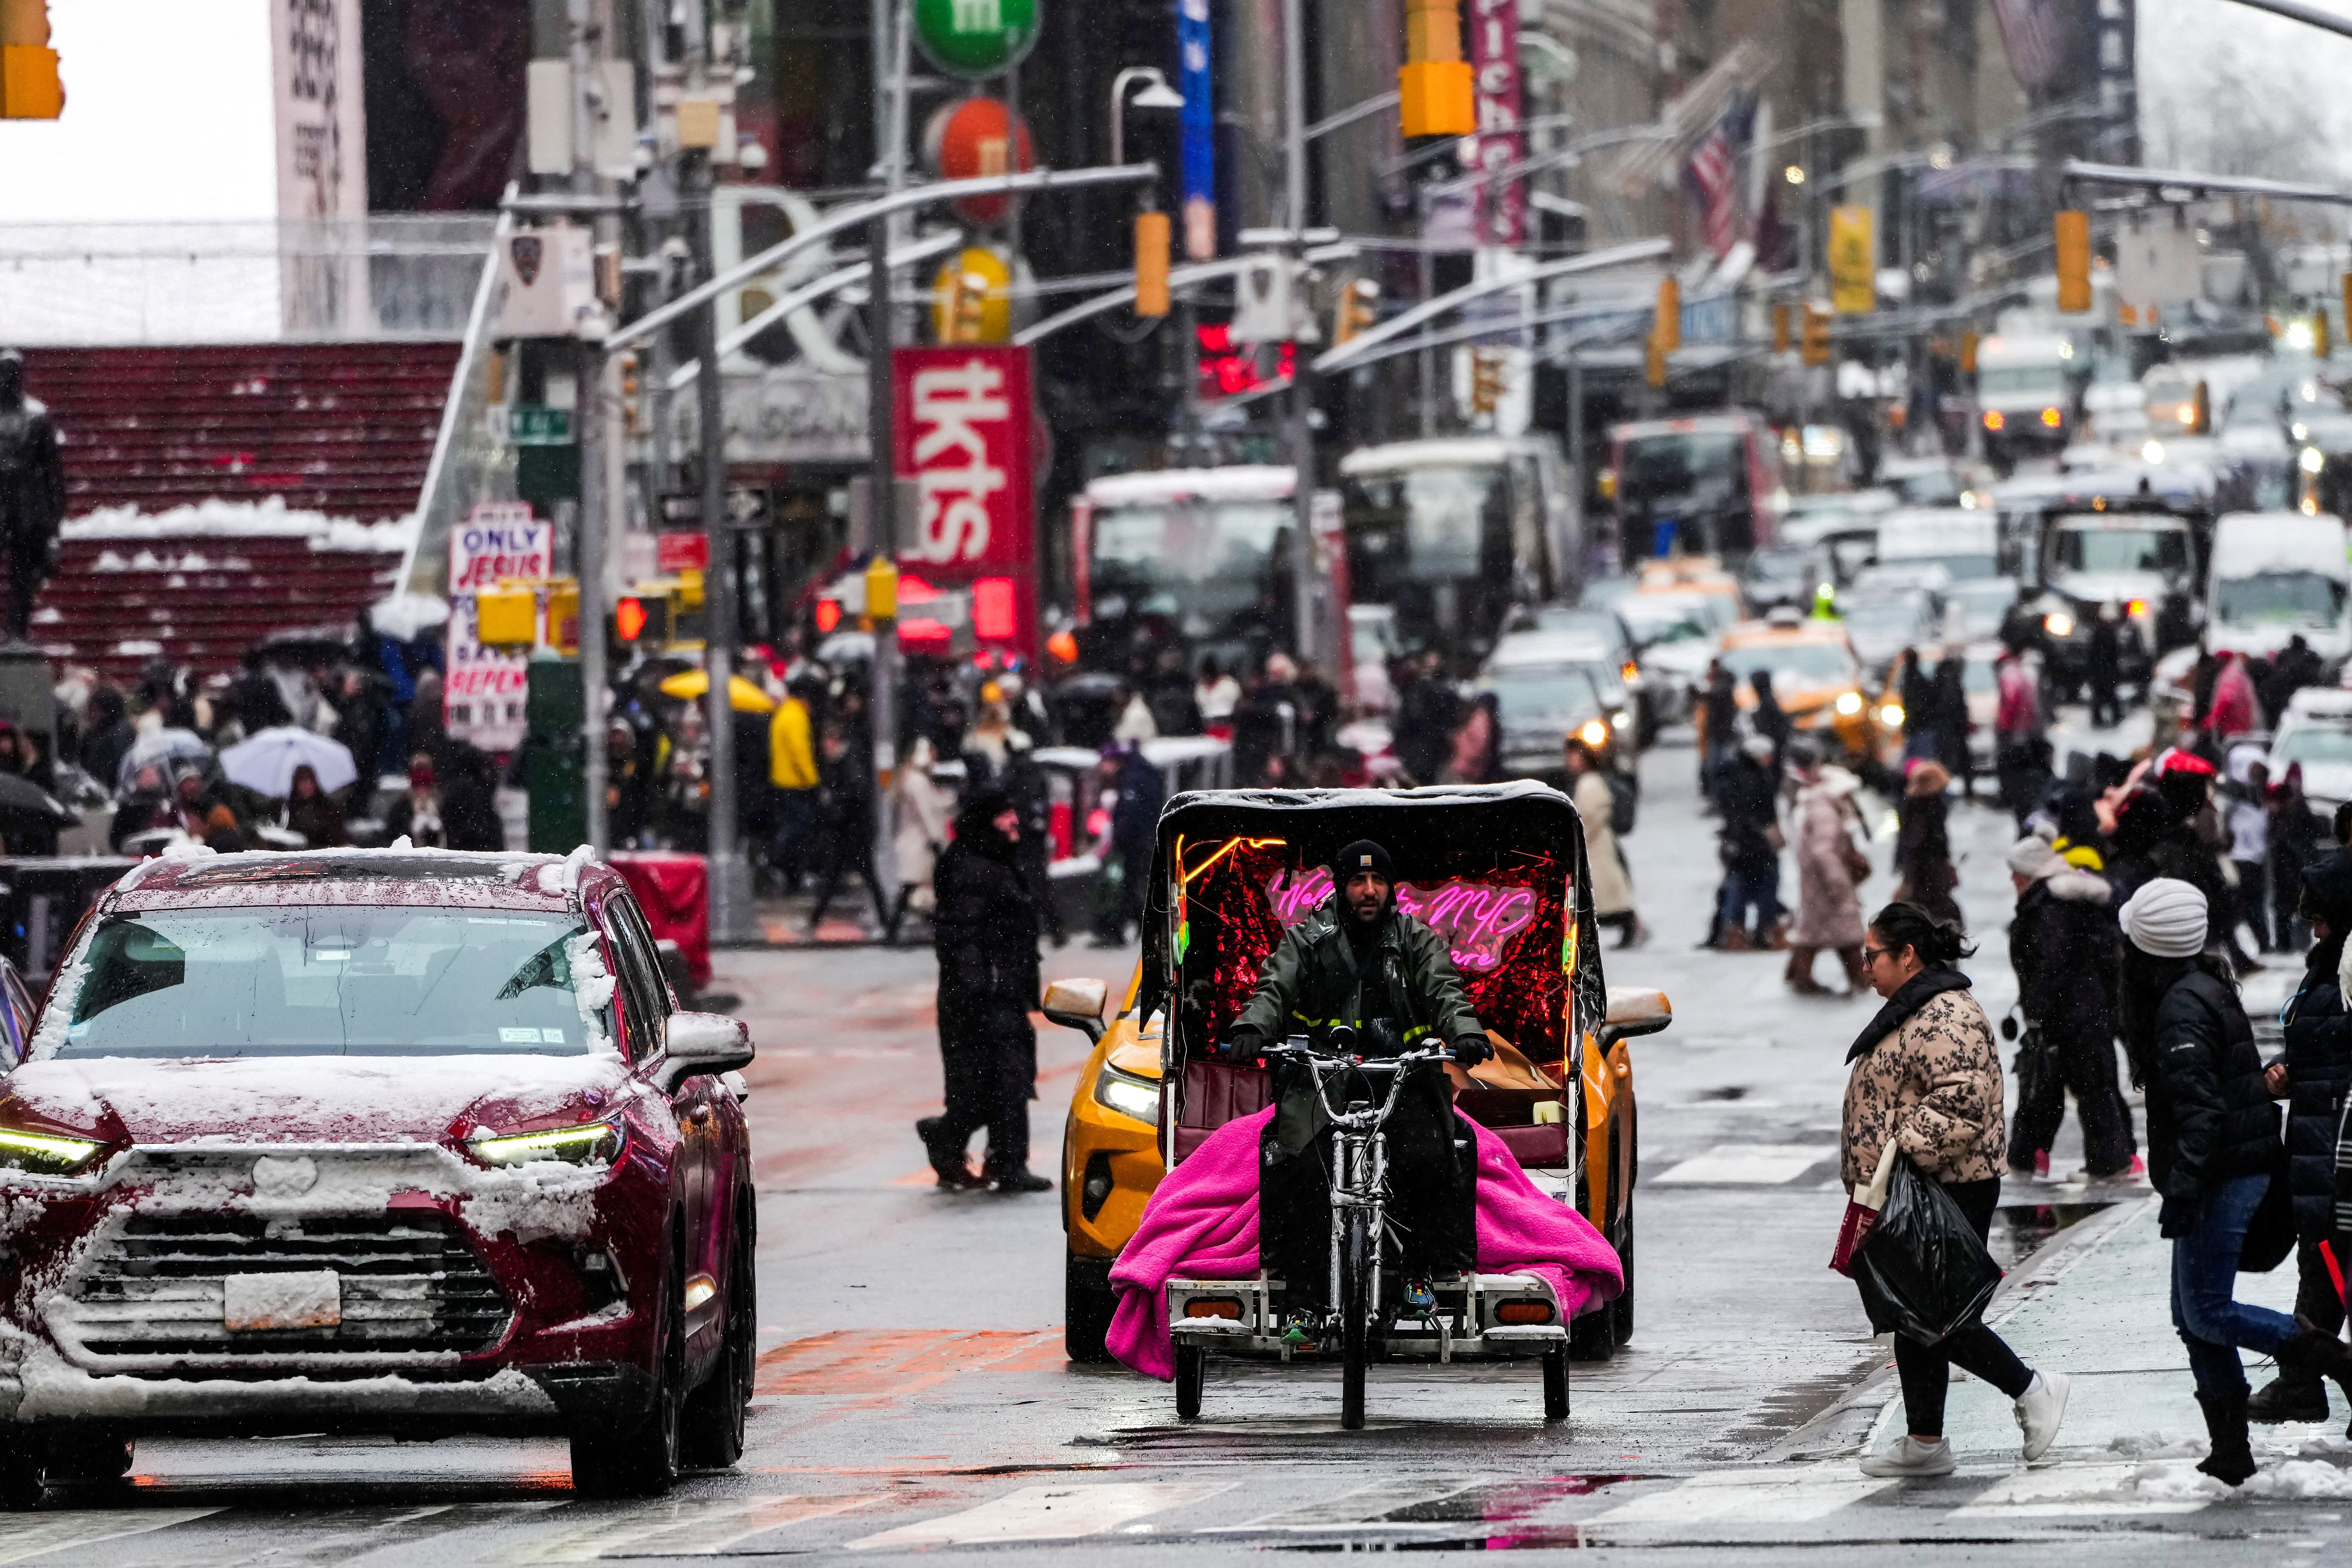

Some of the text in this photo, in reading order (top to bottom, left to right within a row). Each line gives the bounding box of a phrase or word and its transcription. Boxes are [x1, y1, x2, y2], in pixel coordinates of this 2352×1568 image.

[913, 359, 1009, 564] tkts
[463, 528, 539, 553] ONLY
[1428, 885, 1532, 945] NYC
